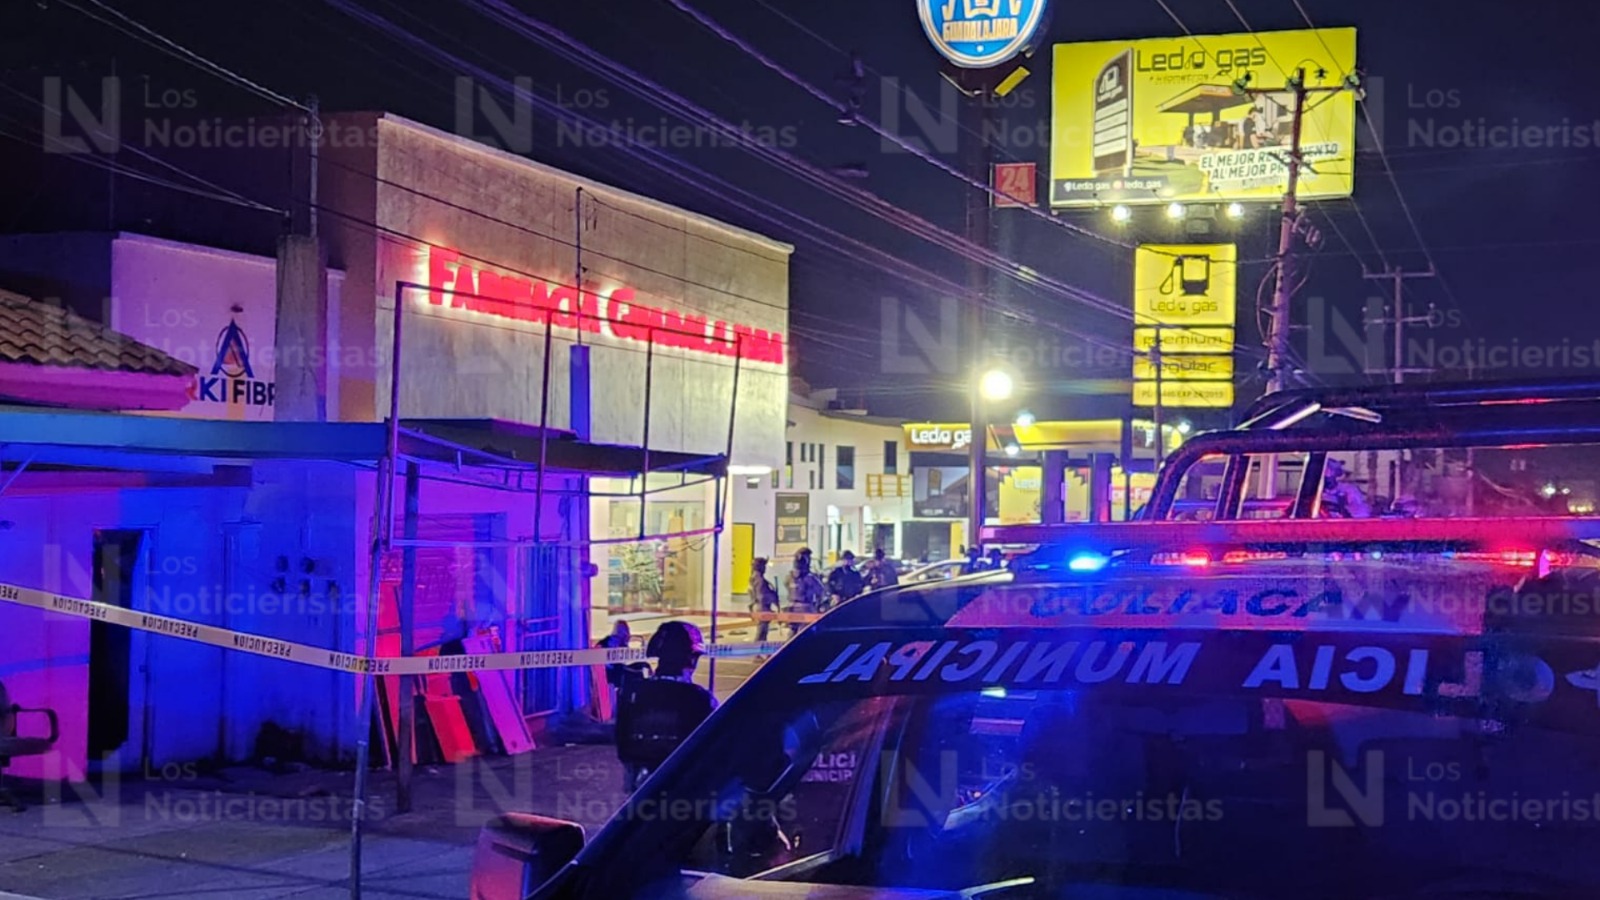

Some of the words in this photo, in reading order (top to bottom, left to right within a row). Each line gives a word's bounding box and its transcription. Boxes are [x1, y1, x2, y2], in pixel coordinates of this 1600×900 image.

[1216, 47, 1266, 76] gas
[1201, 156, 1214, 168] EL
[1217, 152, 1256, 166] MEJOR
[1001, 166, 1029, 192] 24
[1211, 169, 1226, 180] AL
[1229, 164, 1267, 178] MEJOR
[1191, 301, 1219, 315] gas
[53, 596, 107, 619] PRECAUCION
[142, 615, 199, 638] PRECAUCION
[233, 634, 292, 657] PRECAUCION
[329, 653, 390, 672] PRECAUCION
[428, 656, 486, 670] PRECAUCION
[520, 651, 574, 666] PRECAUCION
